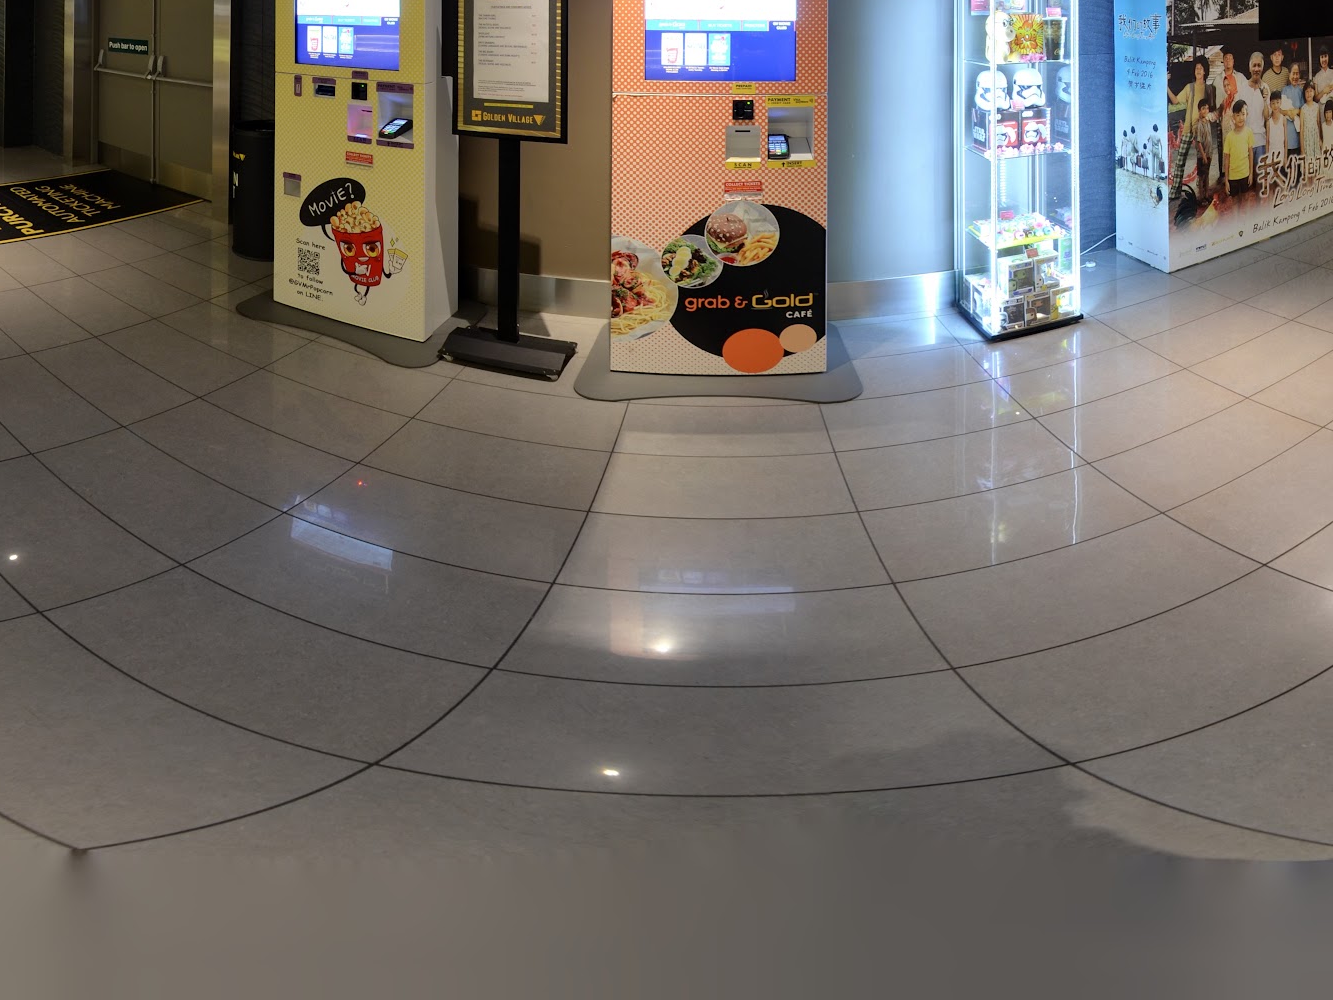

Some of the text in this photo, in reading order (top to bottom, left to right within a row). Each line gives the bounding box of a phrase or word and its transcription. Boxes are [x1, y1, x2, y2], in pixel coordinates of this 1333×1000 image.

[1124, 56, 1157, 70] Balik Kampong
[1141, 70, 1153, 78] 2016
[483, 112, 533, 124] GOLDEN VILLAGE
[35, 186, 101, 217] TICKETING
[59, 184, 121, 210] MACHINE
[1273, 176, 1333, 209] Long Long Time
[10, 186, 85, 222] AUTOMATED
[1253, 220, 1271, 234] Balik
[1271, 211, 1301, 227] Kampong
[1307, 202, 1319, 213] Feb
[1320, 198, 1333, 208] 2016
[295, 238, 325, 250] Scan here
[289, 278, 333, 296] @GVMrPopcorn
[306, 275, 323, 284] follow
[685, 292, 814, 312] grab & Gold
[785, 309, 813, 318] CAFÉ
